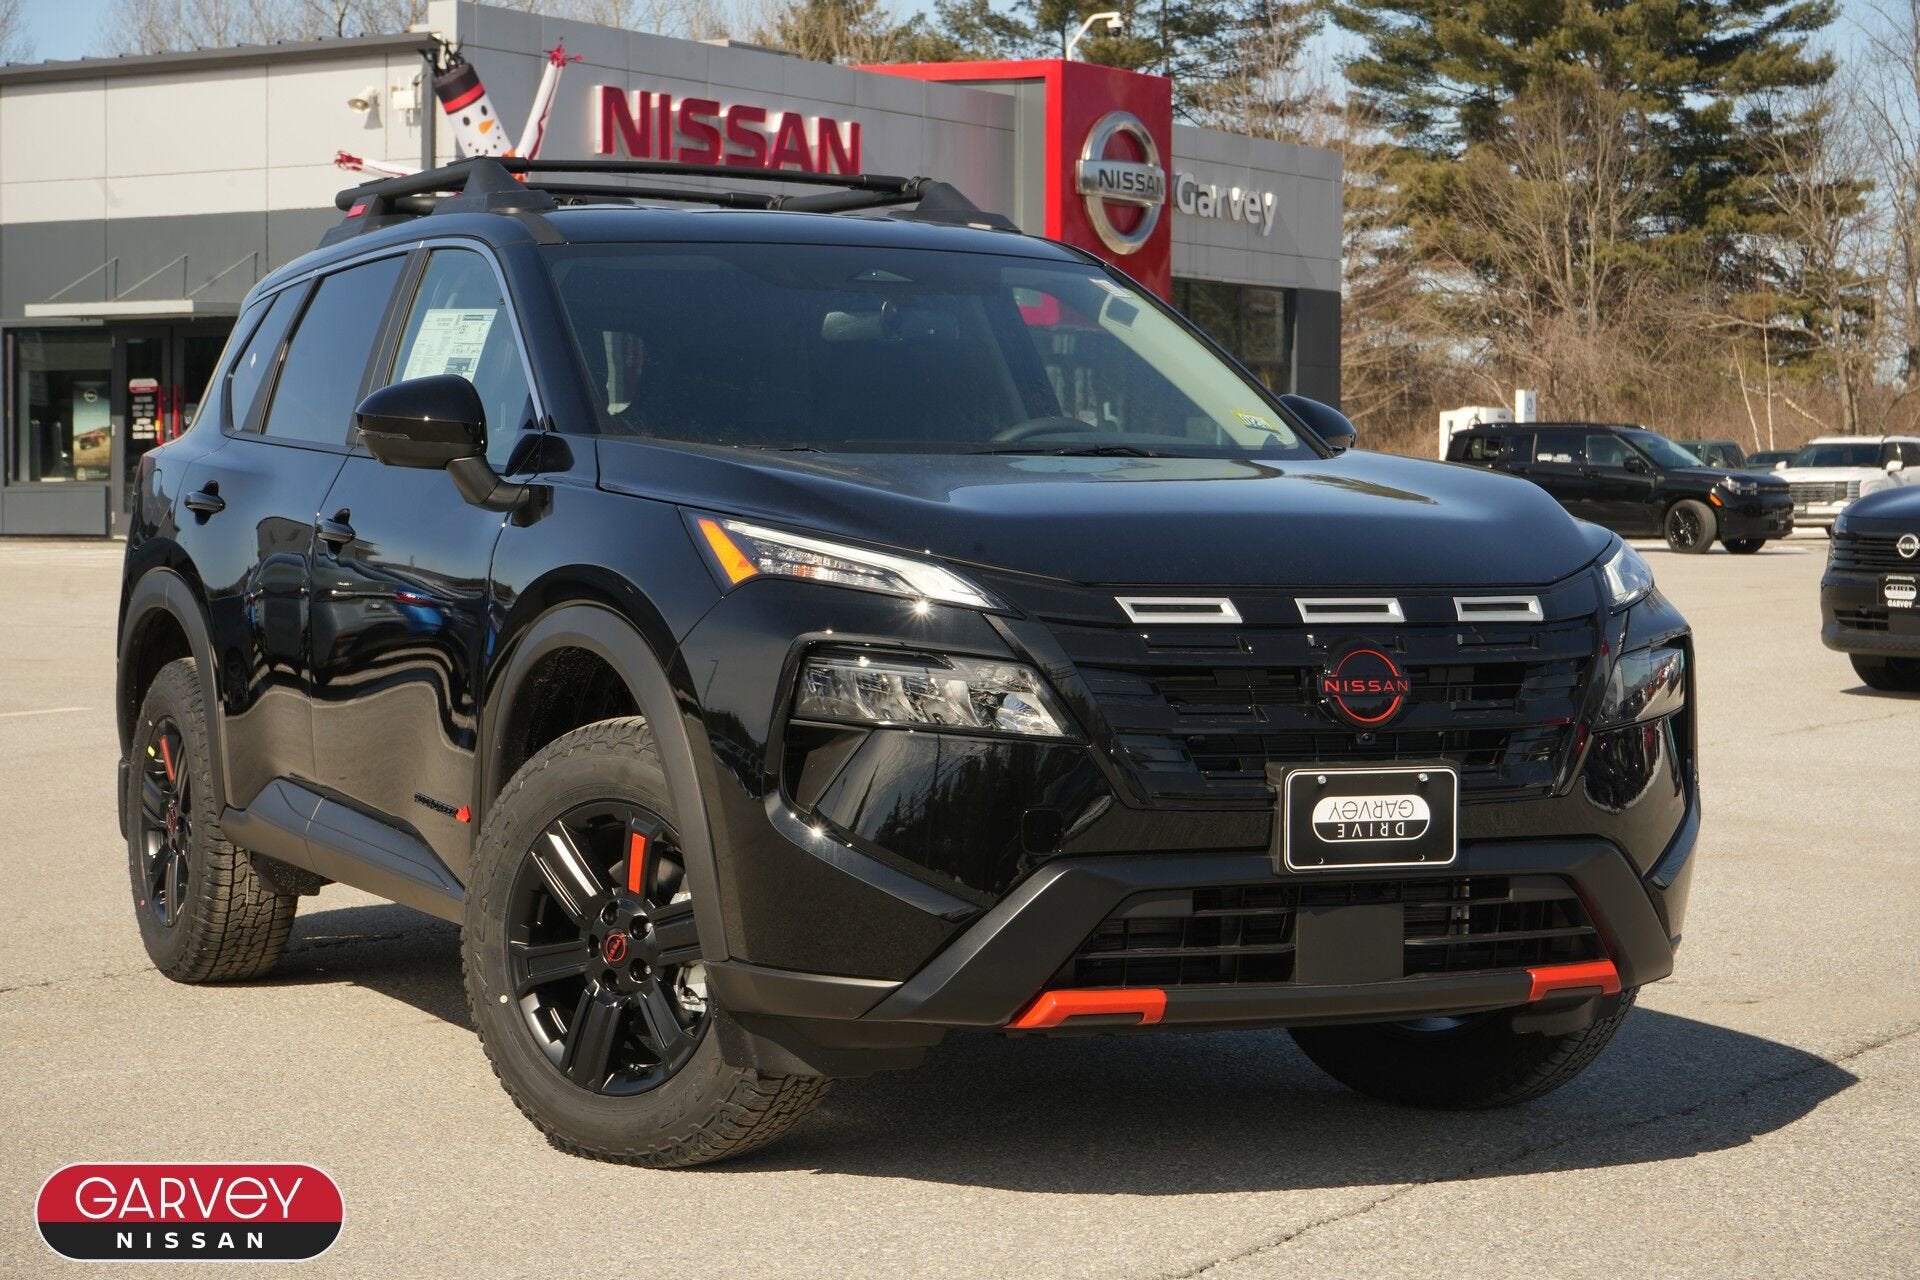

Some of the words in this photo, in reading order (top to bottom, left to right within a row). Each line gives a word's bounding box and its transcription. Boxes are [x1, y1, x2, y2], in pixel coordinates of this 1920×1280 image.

[600, 84, 861, 176] NISSAN
[1097, 168, 1164, 195] NISSAN
[1176, 172, 1278, 236] Garvey
[1323, 679, 1409, 692] NISSAN
[1337, 821, 1405, 838] DRIVE
